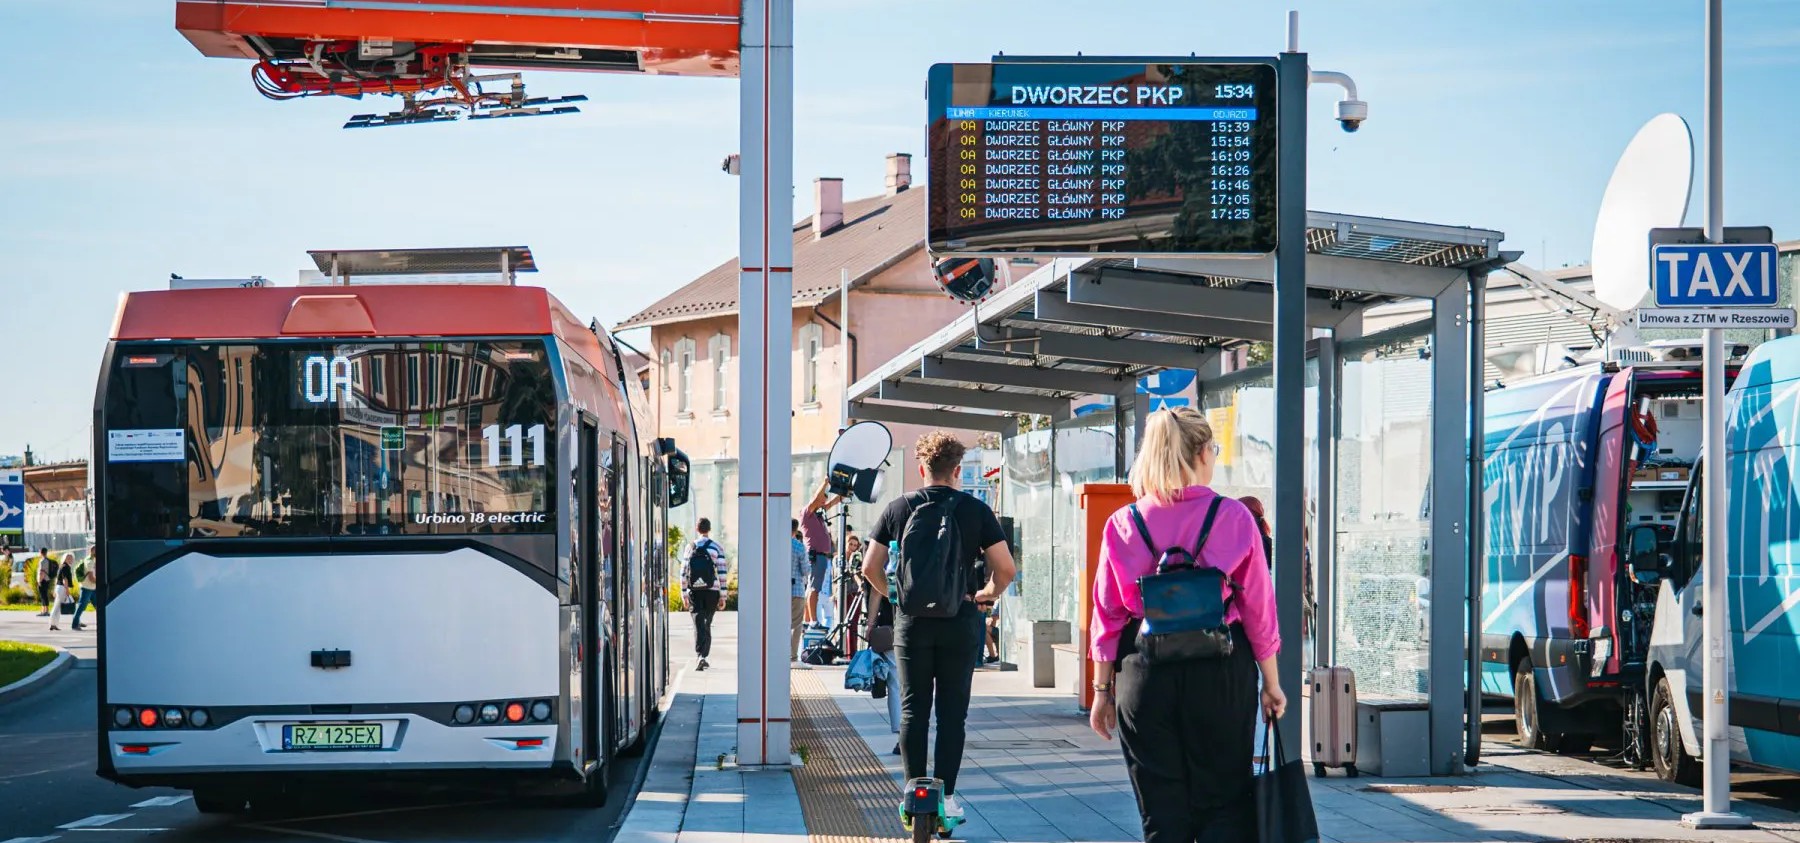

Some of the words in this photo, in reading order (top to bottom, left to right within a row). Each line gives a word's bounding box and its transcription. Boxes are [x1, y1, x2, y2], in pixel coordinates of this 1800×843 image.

[1011, 86, 1129, 105] DWORZEC
[1136, 86, 1183, 105] PKP
[1214, 84, 1254, 99] 15:34
[953, 109, 976, 118] LINIA
[988, 109, 1030, 118] KIERUNEK
[1212, 110, 1248, 119] ODJAZD
[985, 120, 1040, 131] DWORZEC
[1047, 120, 1094, 131] GŁÓWNY
[1101, 120, 1126, 131] PKP
[1211, 121, 1250, 132] 15:39
[985, 135, 1040, 146] DWORZEC
[1047, 135, 1094, 146] GŁÓWNY
[1101, 135, 1126, 146] PKP
[1211, 136, 1250, 147] 15:54
[985, 149, 1040, 160] DWORZEC
[1047, 149, 1094, 160] GŁÓWNY
[1101, 149, 1126, 160] PKP
[1211, 150, 1250, 161] 16:09
[985, 164, 1040, 175] DWORZEC
[1047, 164, 1094, 175] GŁÓWNY
[1101, 164, 1126, 175] PKP
[1211, 165, 1250, 176] 16:26
[985, 178, 1040, 189] DWORZEC
[1047, 178, 1094, 189] GŁÓWNY
[1101, 178, 1126, 189] PKP
[1211, 179, 1250, 190] 16:46
[985, 193, 1040, 204] DWORZEC
[1047, 193, 1094, 204] GŁÓWNY
[1101, 193, 1126, 204] PKP
[1211, 194, 1250, 205] 17:05
[985, 207, 1040, 218] DWORZEC
[1047, 207, 1094, 218] GŁÓWNY
[1101, 207, 1126, 218] PKP
[1211, 208, 1250, 219] 17:25
[1658, 251, 1770, 297] TAXI
[1639, 313, 1680, 324] Umowa
[1683, 315, 1690, 324] z
[1692, 313, 1716, 324] ZTM
[1719, 315, 1729, 324] w
[1731, 313, 1790, 324] Rzeszowie
[482, 424, 545, 467] 111
[415, 513, 466, 524] Urbino
[469, 512, 485, 524] 18
[488, 512, 546, 524] electric
[295, 727, 317, 744] RZ
[325, 727, 376, 744] 125EX
